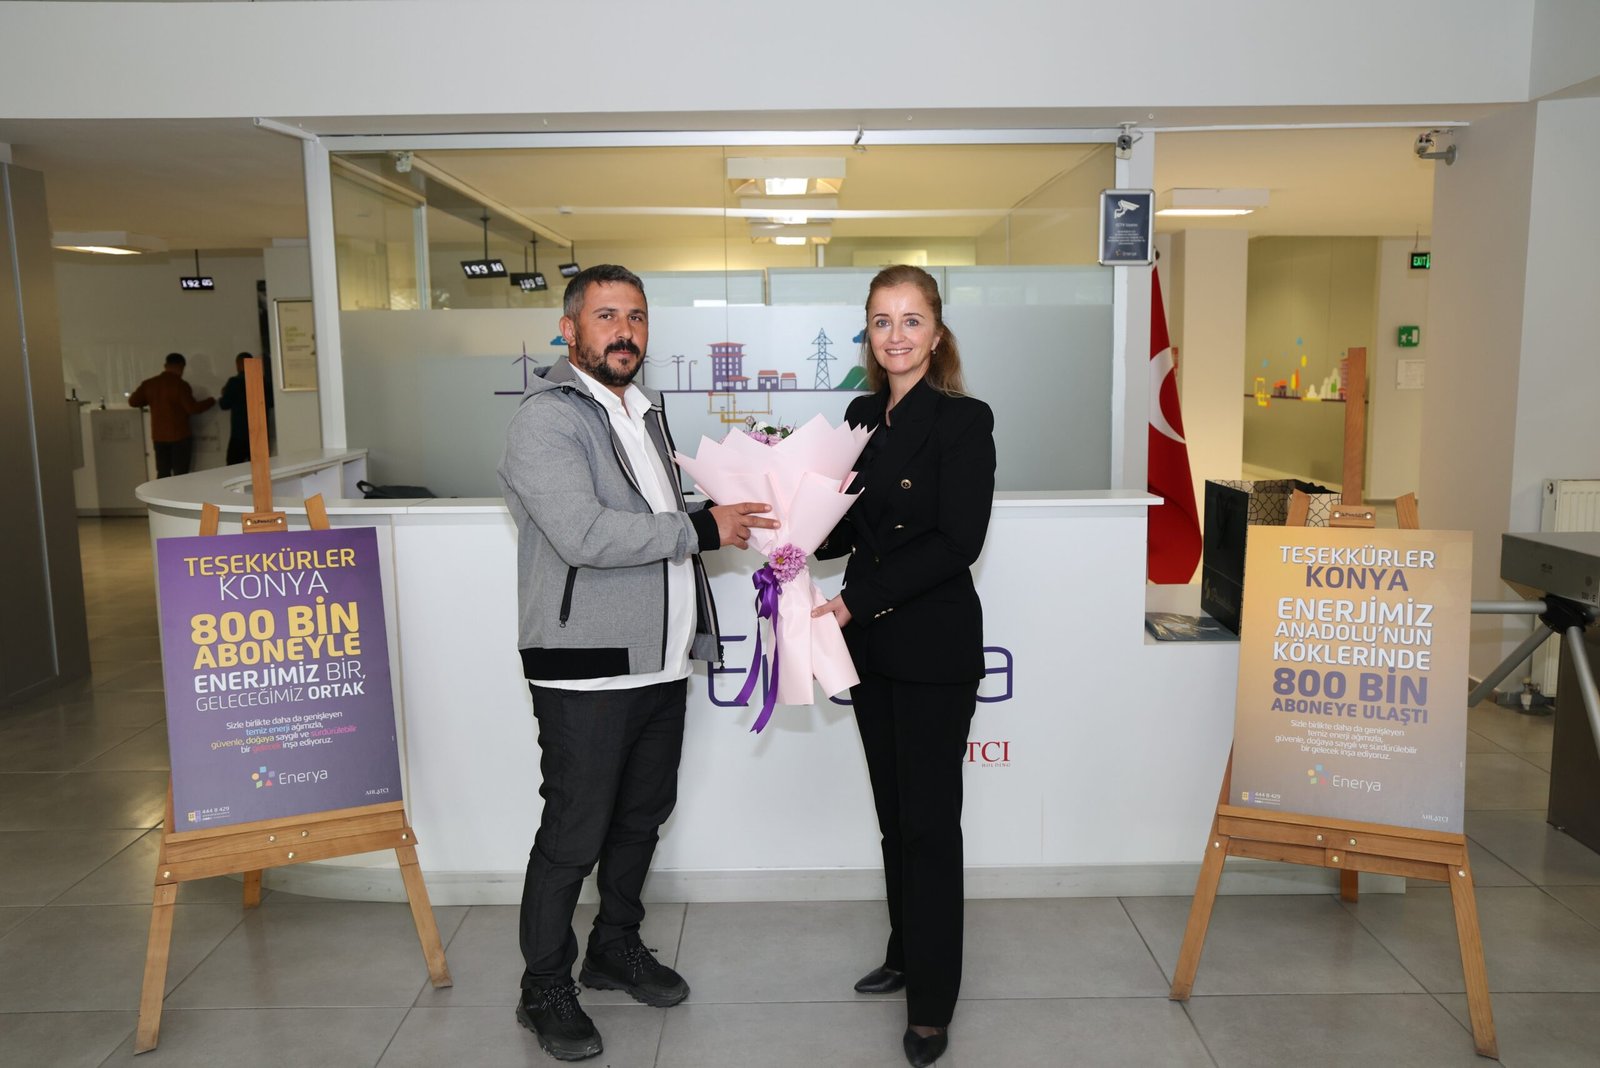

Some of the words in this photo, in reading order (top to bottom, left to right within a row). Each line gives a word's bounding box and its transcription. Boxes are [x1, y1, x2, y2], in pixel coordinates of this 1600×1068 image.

[464, 264, 489, 275] 193
[1413, 256, 1426, 266] EXIT
[181, 279, 200, 288] 192
[184, 547, 356, 579] TEŞEKKÜRLER
[1279, 544, 1435, 569] TEŞEKKÜRLER
[219, 570, 329, 601] KONYA
[1305, 565, 1409, 592] KONYA
[190, 608, 275, 646] 800
[287, 595, 360, 638] BİN
[1277, 596, 1434, 628] ENERJİMİZ
[193, 632, 361, 670] ABONEYLE
[1272, 638, 1431, 671] KÖKLERİNDE
[194, 661, 320, 694] ENERJİMİZ
[326, 658, 366, 682] BİR,
[1272, 667, 1347, 700] 800
[1358, 667, 1428, 706] BİN
[196, 686, 304, 712] GELECEĞİMİZ
[307, 680, 365, 700] ORTAK
[226, 721, 244, 730] Sizle
[245, 718, 271, 728] birlikte
[272, 716, 291, 725] daha
[292, 715, 302, 723] da
[303, 710, 343, 723] genişleyen
[1270, 697, 1357, 718] ABONEYE
[1362, 704, 1428, 725] ULAŞTI
[246, 727, 268, 736] temiz
[269, 725, 290, 735] enerji
[291, 721, 324, 732] ağımızla,
[1290, 719, 1307, 728] Sizle
[1308, 721, 1333, 731] birlikte
[1333, 724, 1352, 732] daha
[1353, 725, 1363, 733] da
[1364, 726, 1405, 738] genişleyen
[1307, 729, 1328, 738] temiz
[1329, 732, 1350, 741] enerji
[211, 738, 245, 751] güvenle,
[246, 735, 274, 746] doğaya
[275, 732, 298, 743] saygılı
[299, 730, 309, 738] ve
[241, 744, 251, 754] bir
[282, 740, 298, 750] inşa
[299, 737, 333, 748] ediyoruz.
[1274, 734, 1305, 745] güvenle,
[1306, 737, 1334, 748] doğaya
[1334, 740, 1357, 751] saygılı
[1358, 742, 1368, 750] ve
[1369, 742, 1418, 754] sürdürülebilir
[966, 741, 1011, 762] TCI
[1301, 744, 1311, 753] bir
[1311, 746, 1340, 756] gelecek
[1340, 747, 1356, 758] inşa
[1356, 750, 1391, 761] ediyoruz.
[279, 769, 328, 785] Enerya
[1332, 775, 1382, 792] Enerya
